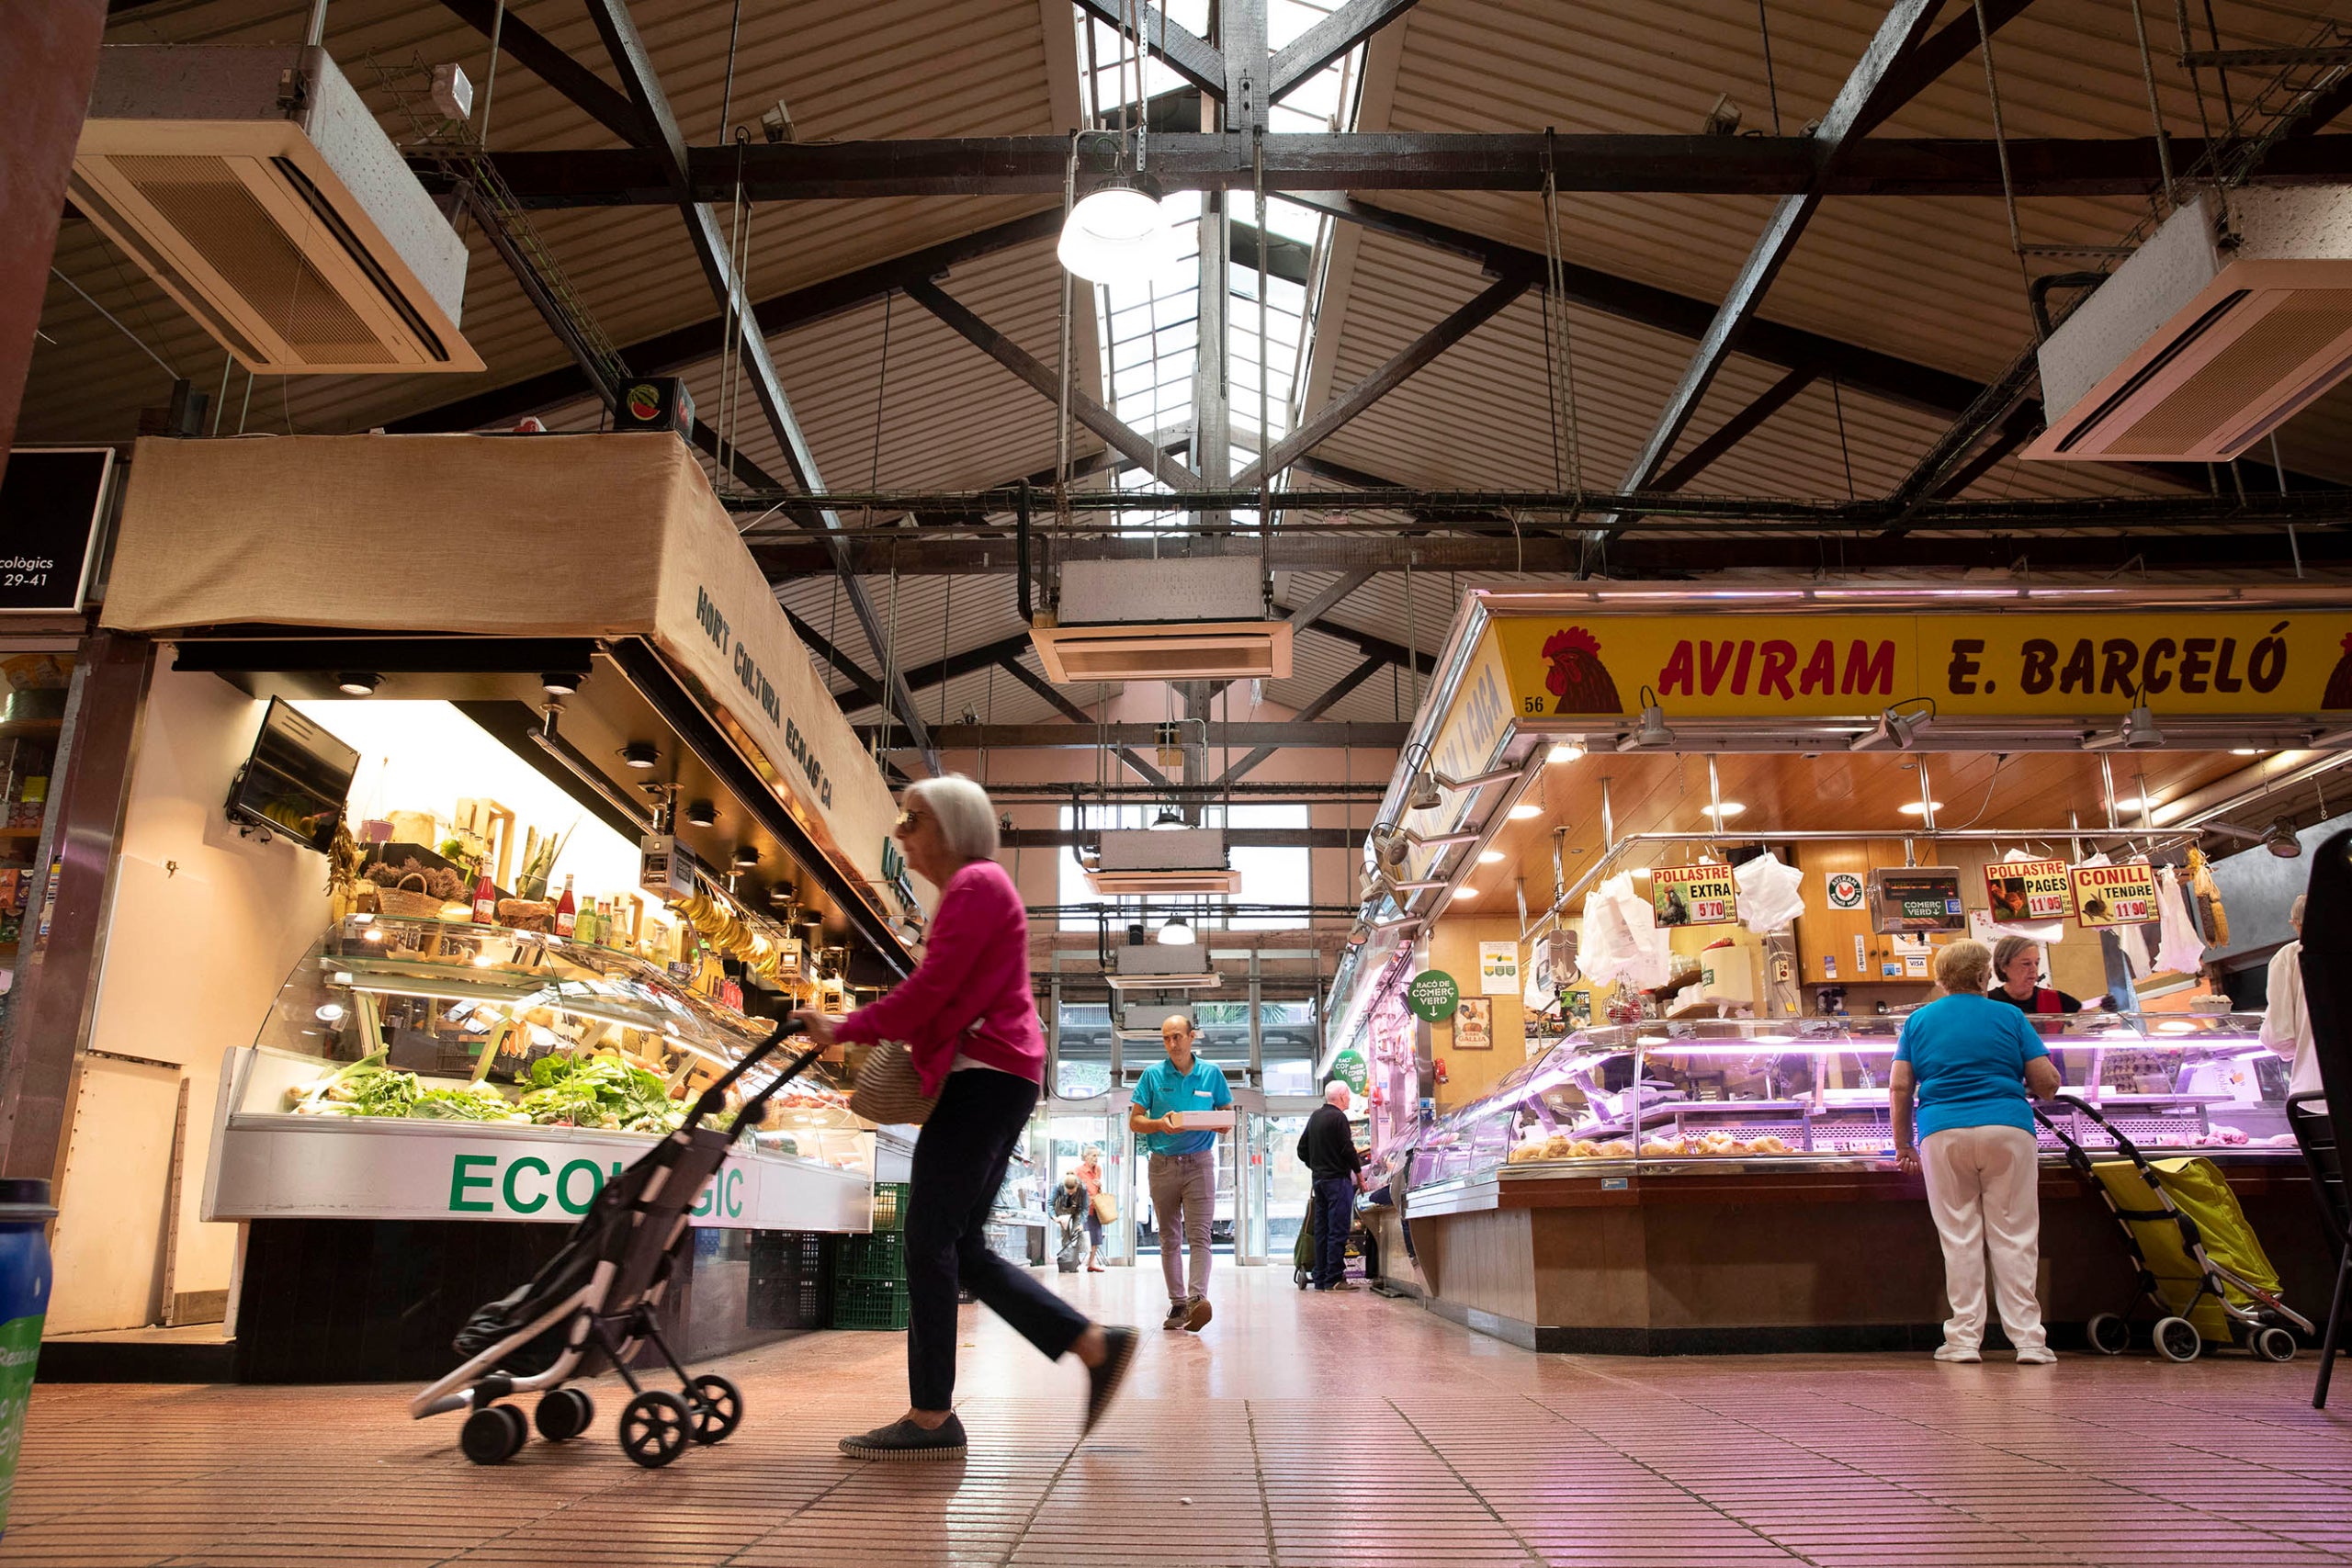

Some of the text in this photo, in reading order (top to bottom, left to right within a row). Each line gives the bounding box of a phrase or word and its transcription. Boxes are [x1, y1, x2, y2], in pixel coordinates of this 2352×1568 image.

[0, 556, 53, 571] cològics
[4, 574, 47, 586] 29-41
[695, 585, 730, 655] HORT
[734, 641, 780, 728] CULTURA
[1657, 620, 2290, 701] AVIRAM E. BARCELÓ
[1524, 696, 1544, 713] 56
[1654, 867, 1729, 883] POLLASTRE
[1989, 862, 2064, 878] POLLASTRE
[2079, 867, 2149, 886] CONILL
[1690, 883, 1731, 898] EXTRA
[2026, 875, 2067, 894] PAGÈS
[2104, 885, 2153, 899] TENDRE
[1699, 902, 1723, 917] 5'70
[1904, 901, 1941, 909] COMERÇ
[2030, 895, 2061, 912] 11'95
[2116, 901, 2146, 918] 11'90
[1416, 979, 1438, 989] RACÓ
[1412, 987, 1454, 998] COMERÇ
[1419, 997, 1448, 1005] VERD
